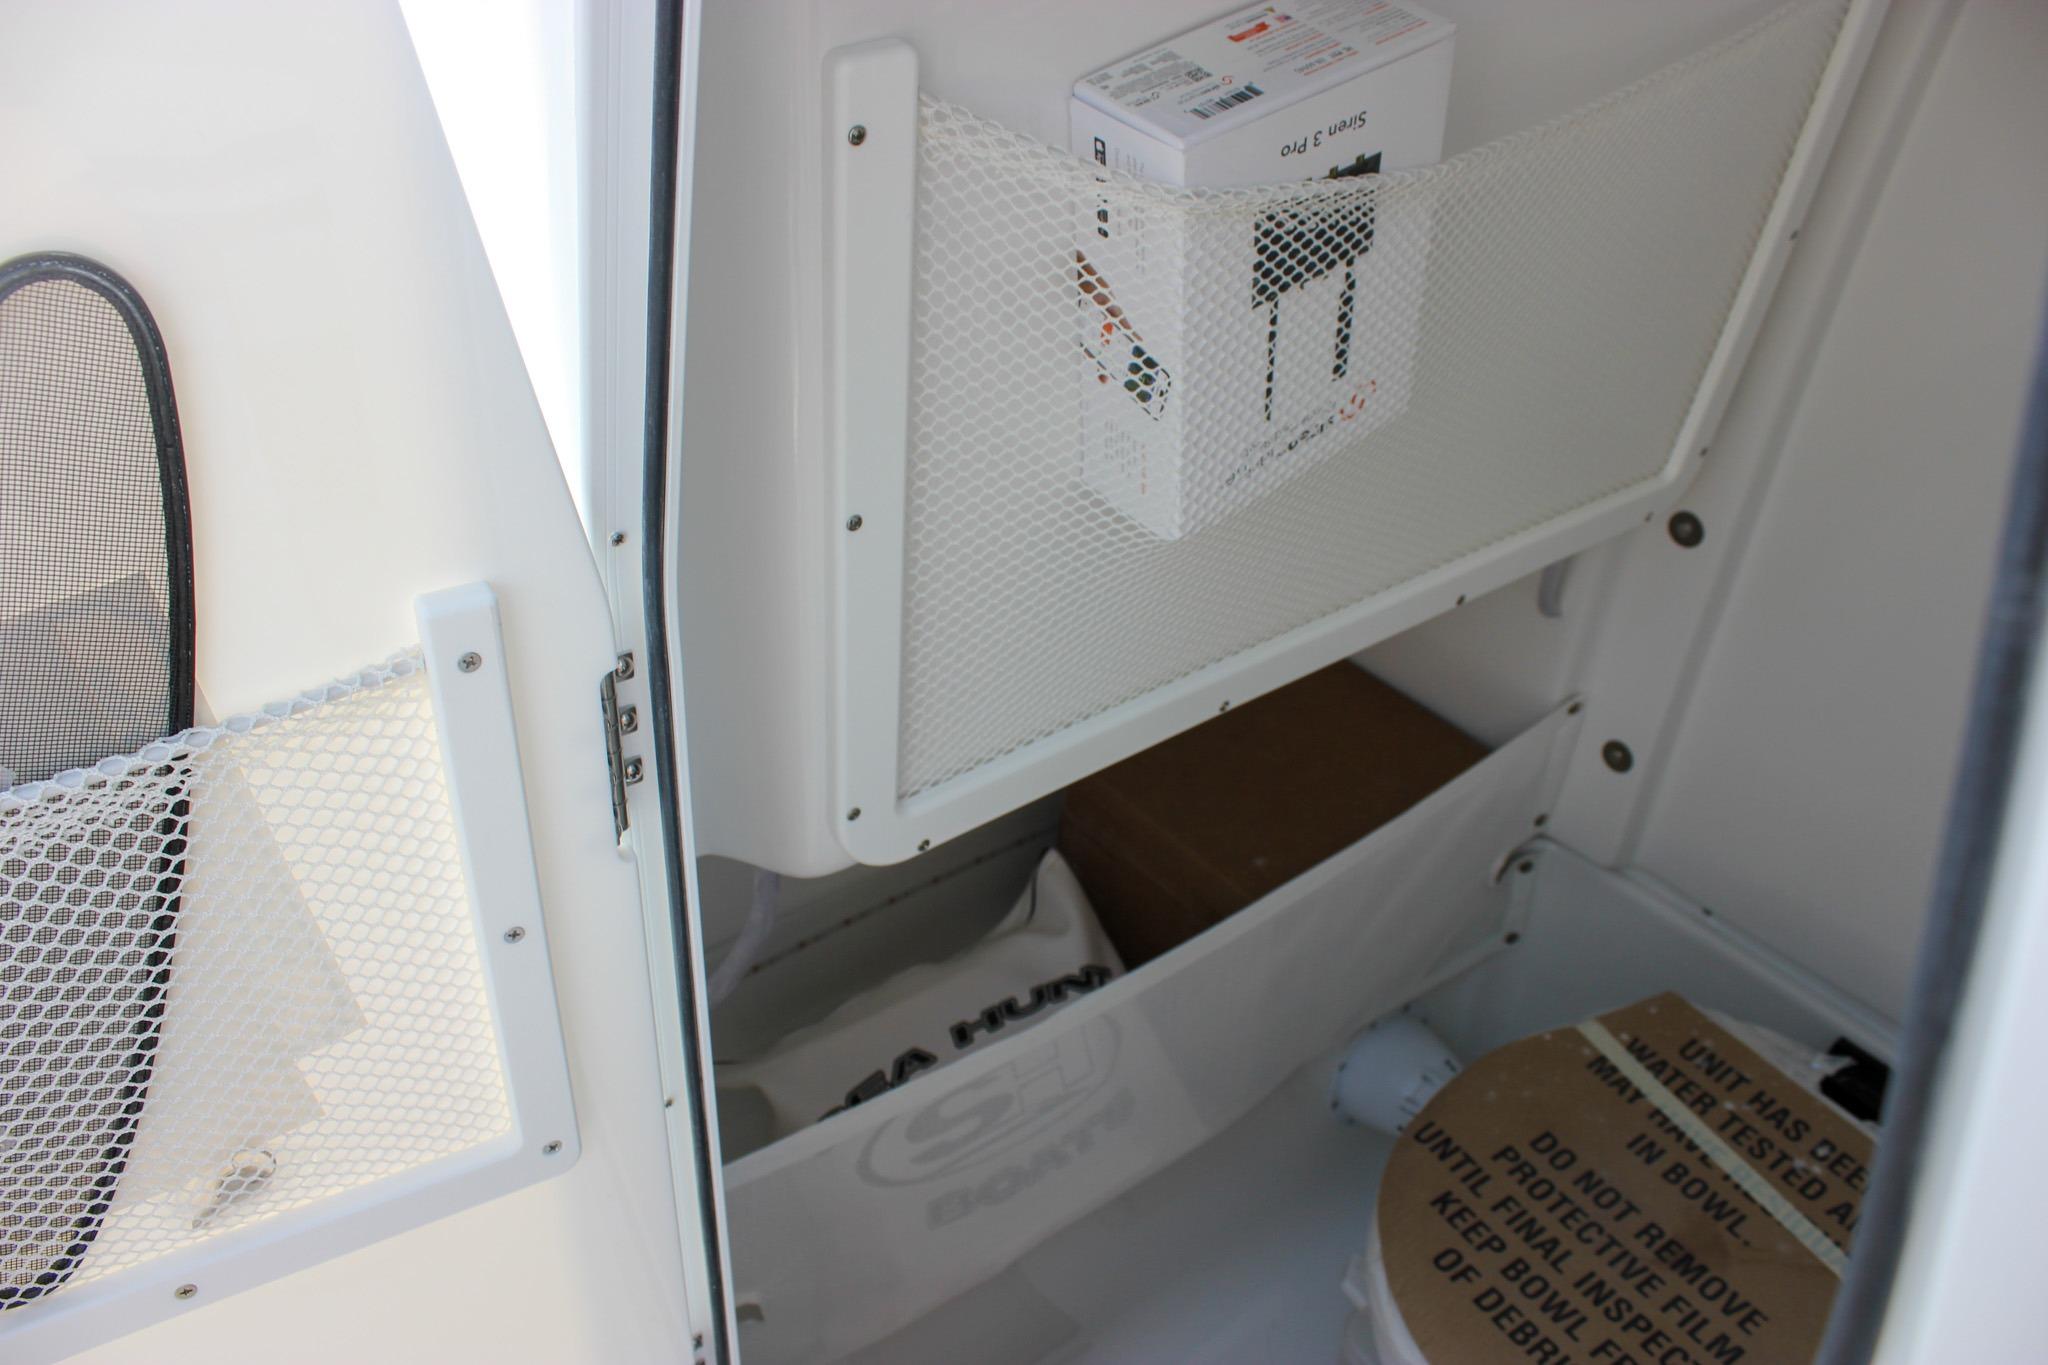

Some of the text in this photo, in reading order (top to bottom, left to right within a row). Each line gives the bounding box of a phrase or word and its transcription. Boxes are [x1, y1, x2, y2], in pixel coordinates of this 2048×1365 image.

[1280, 110, 1367, 157] Siren 3 Pro
[1586, 1053, 1646, 1105] MAY
[1625, 1037, 1717, 1115] WATER
[1717, 1110, 1828, 1200] TESTED
[1679, 1038, 1869, 1195] UNIT HAS BEE
[1413, 1120, 1702, 1365] UNTIL FINAL INSPEC
[1429, 1189, 1507, 1254] KEEP
[1500, 1256, 1589, 1343] BOWL
[1433, 1247, 1482, 1285] OF
[1490, 1144, 1746, 1365] PROTECTIVE FILM
[1529, 1130, 1770, 1336] DO NOT REMOVE
[1626, 1132, 1751, 1247] IN BOWL.
